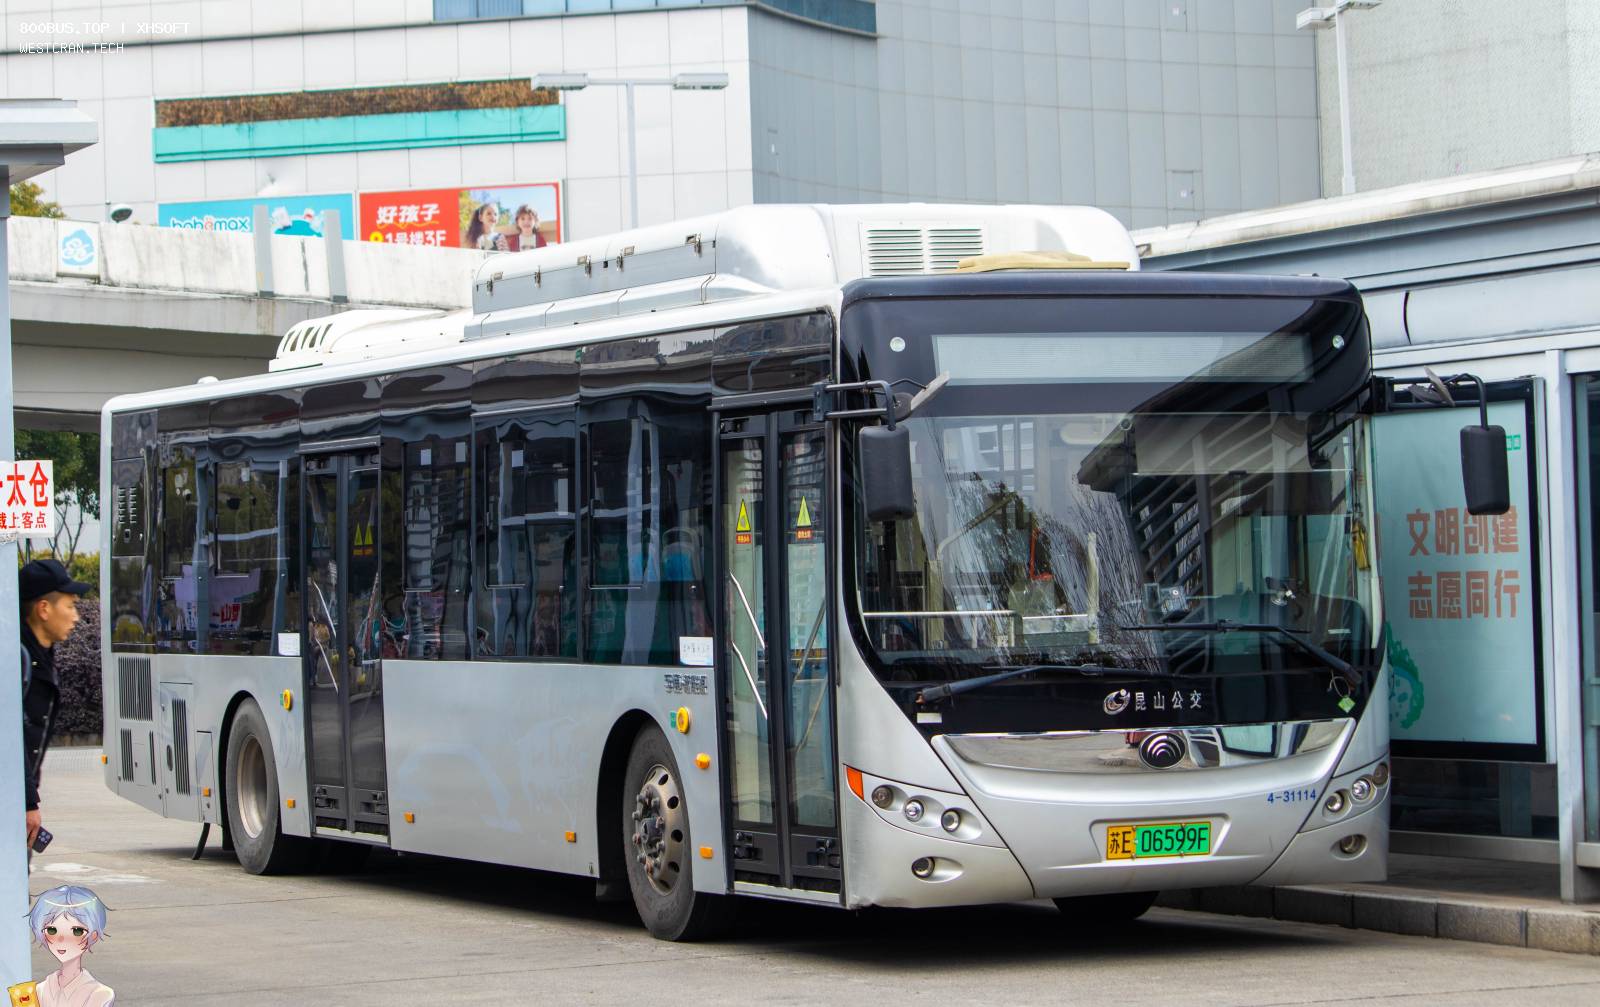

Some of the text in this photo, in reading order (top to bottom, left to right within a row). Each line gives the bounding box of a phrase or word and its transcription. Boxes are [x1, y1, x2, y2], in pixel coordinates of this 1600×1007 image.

[376, 203, 440, 224] 好孩子
[0, 462, 49, 507] 太仓
[1406, 505, 1519, 556] 文明创建
[1408, 569, 1520, 619] 志愿同行
[1135, 690, 1202, 711] 昆山公交
[1267, 789, 1317, 804] 4-31114
